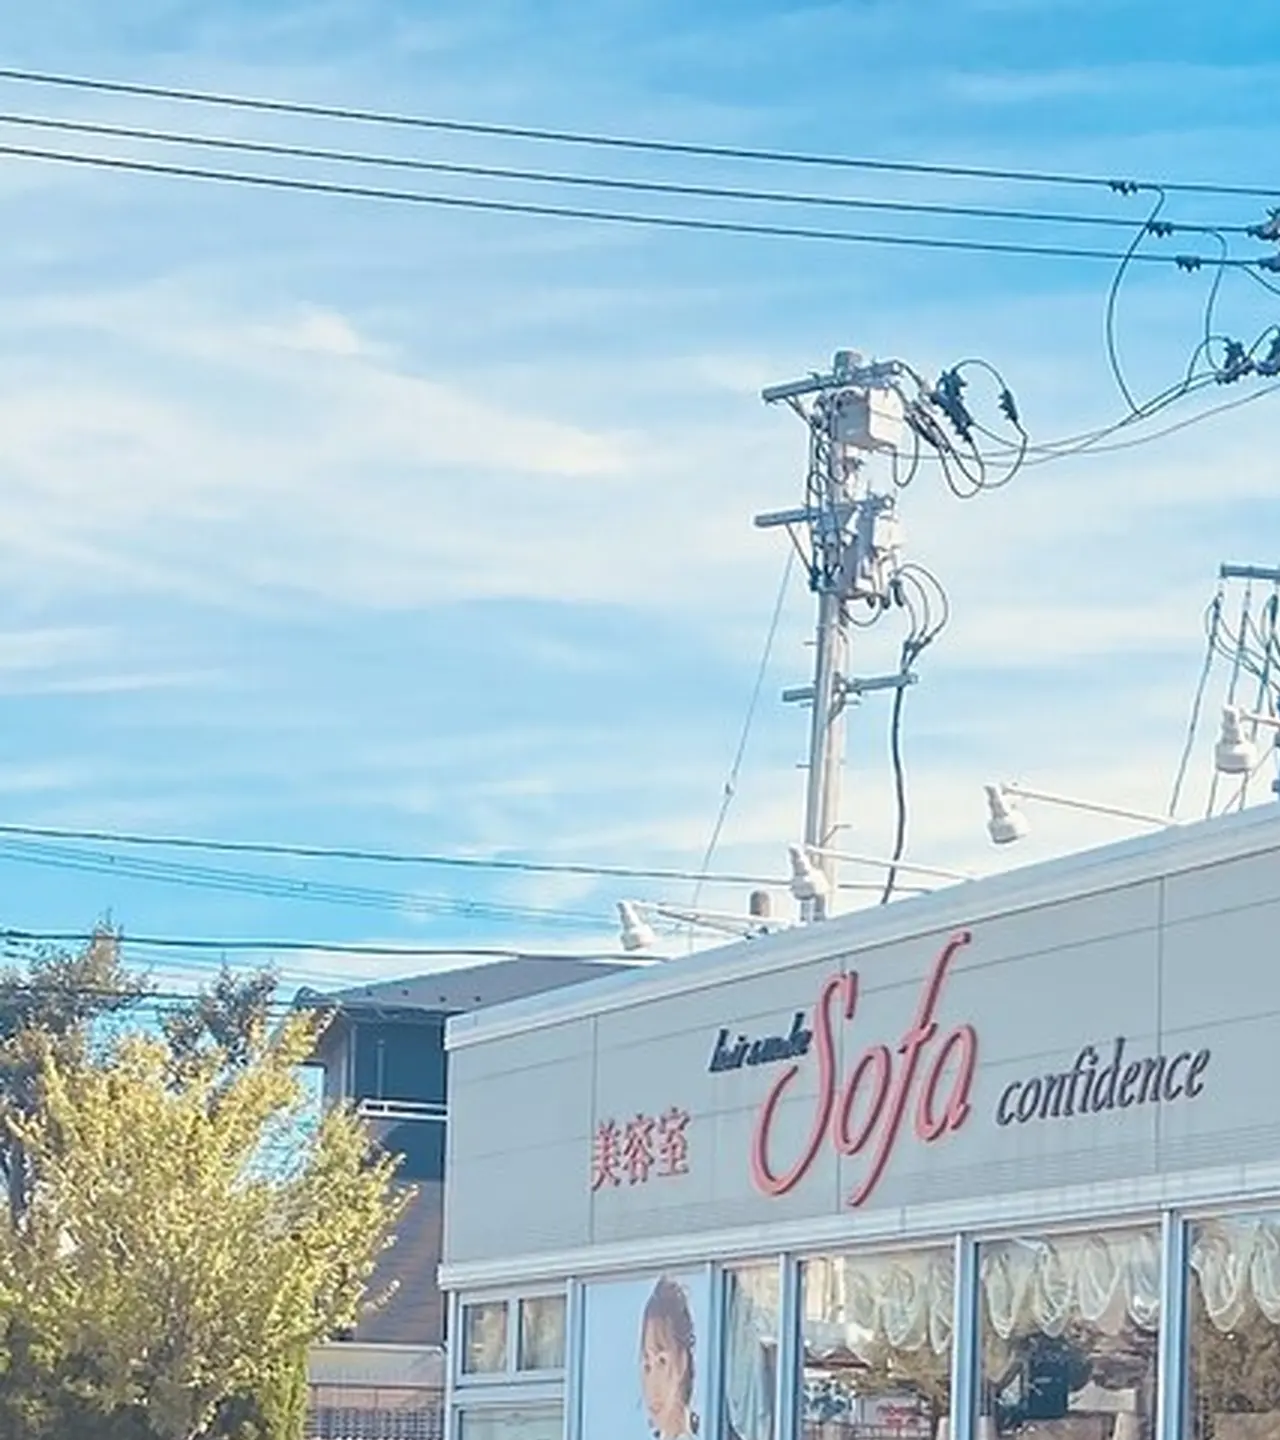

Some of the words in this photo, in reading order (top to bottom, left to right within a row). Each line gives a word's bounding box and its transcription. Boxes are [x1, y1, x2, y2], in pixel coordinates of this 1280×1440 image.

[750, 931, 979, 1207] Sofa
[995, 1036, 1211, 1126] confidence
[591, 1106, 691, 1193] 美容室
